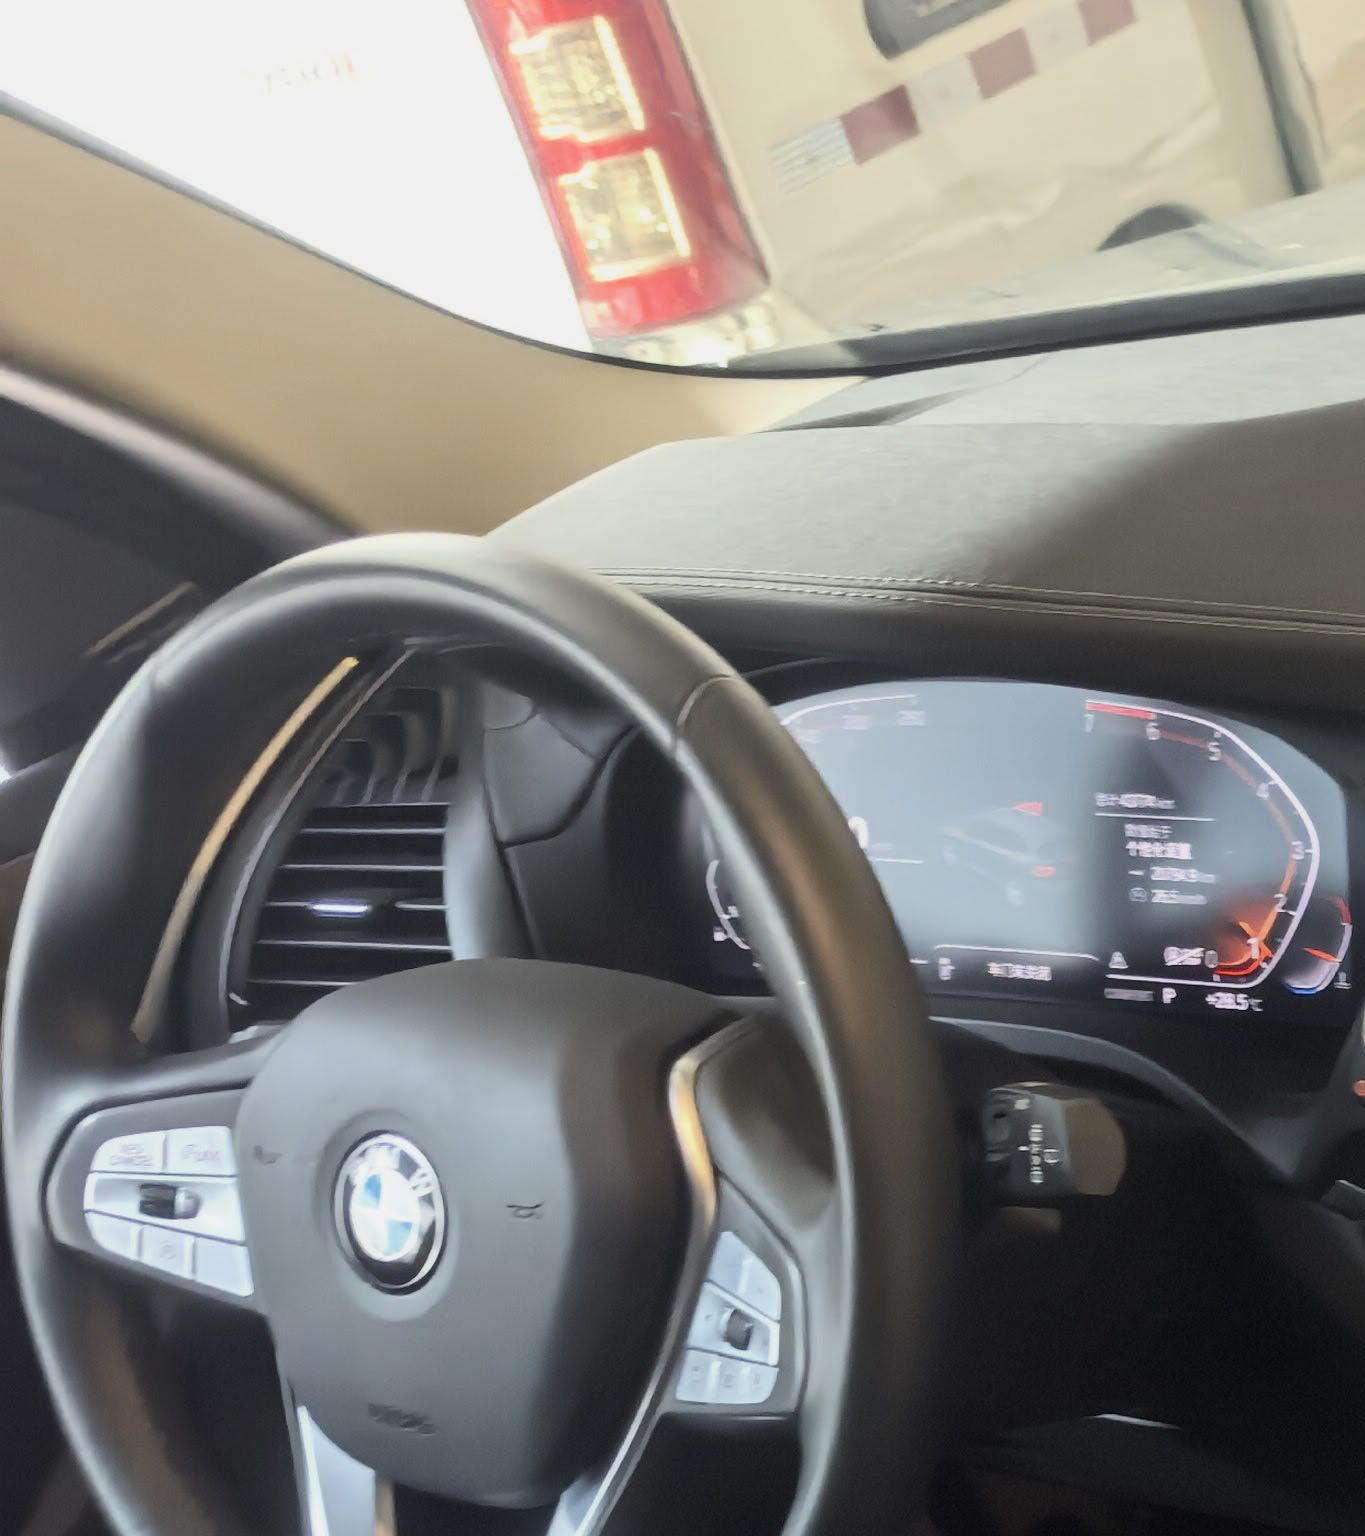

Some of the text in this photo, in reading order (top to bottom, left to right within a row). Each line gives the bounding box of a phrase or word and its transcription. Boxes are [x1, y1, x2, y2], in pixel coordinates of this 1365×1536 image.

[1146, 723, 1161, 740] 6
[1208, 742, 1221, 761] 5
[1291, 841, 1304, 860] 3
[1274, 893, 1288, 912] 2
[1247, 937, 1259, 959] 1
[1162, 987, 1177, 1004] P
